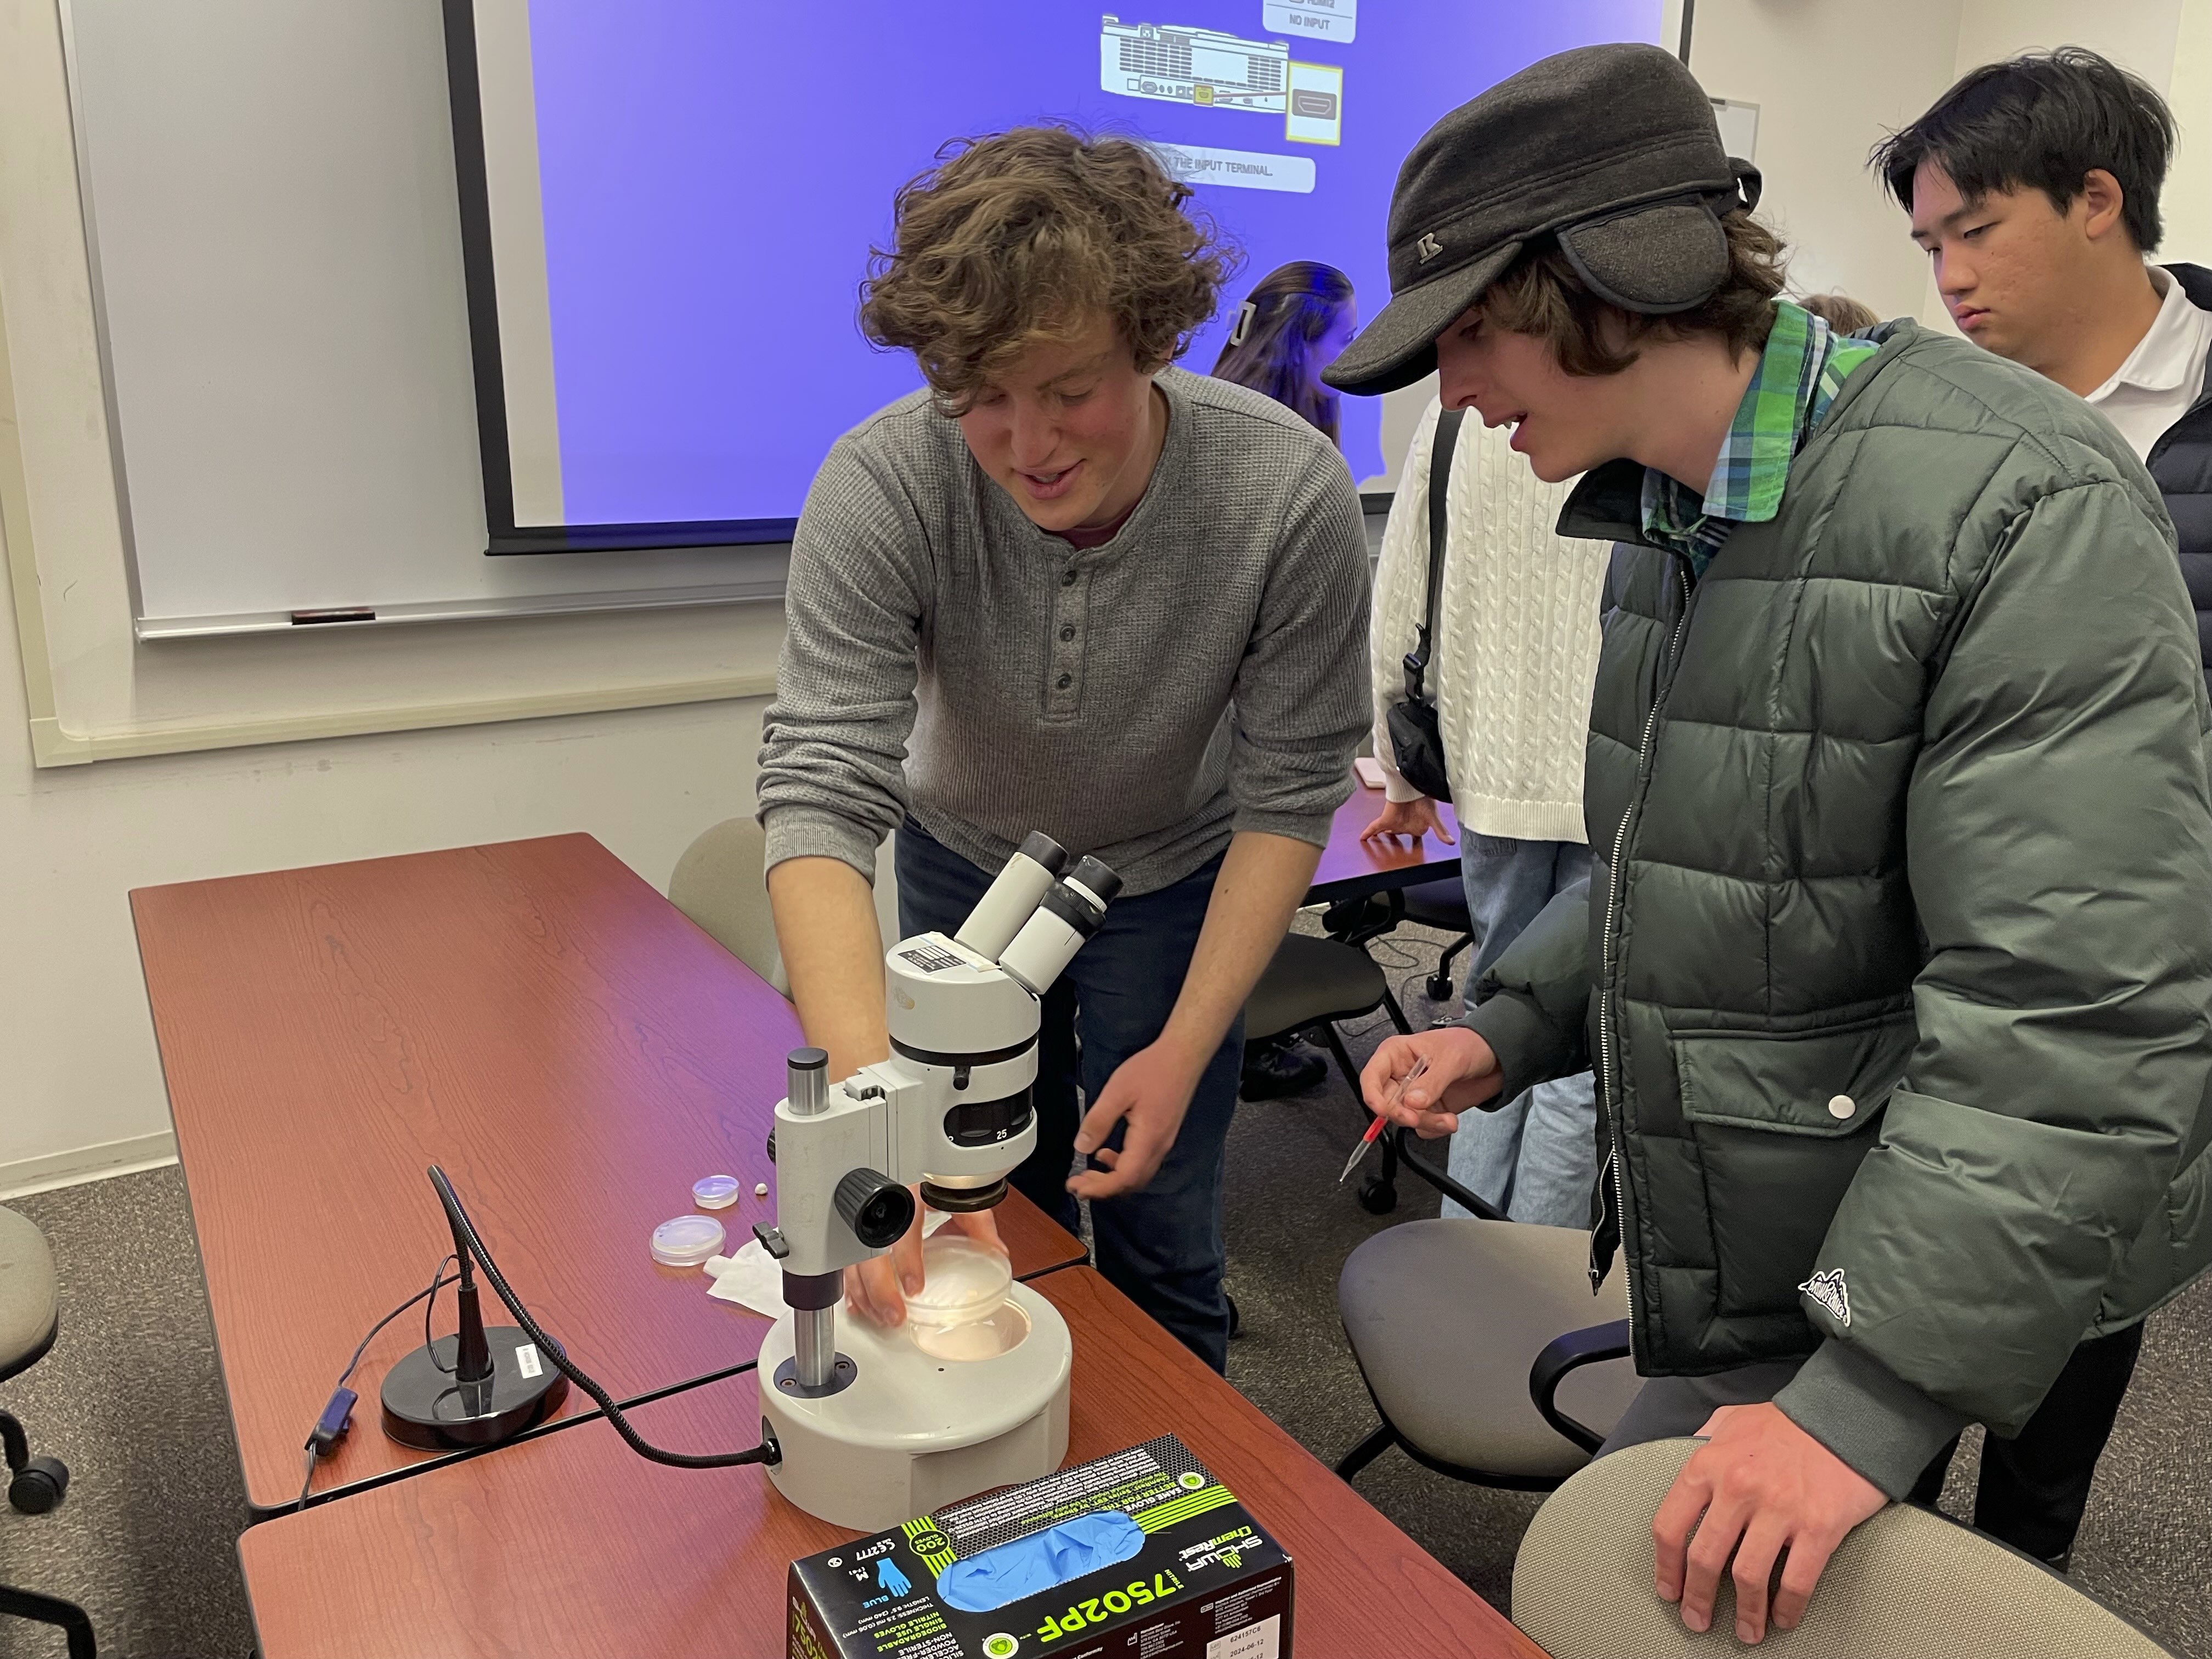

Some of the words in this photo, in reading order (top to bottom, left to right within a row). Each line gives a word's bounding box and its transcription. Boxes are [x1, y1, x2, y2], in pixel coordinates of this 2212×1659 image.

[1290, 13, 1302, 25] NO
[1304, 16, 1330, 30] INPUT
[1174, 157, 1193, 168] THE
[1195, 159, 1223, 171] INPUT
[1225, 161, 1273, 176] TERMINAL.
[996, 1129, 1007, 1140] 25
[1141, 1481, 1177, 1497] BETTER
[1155, 1487, 1182, 1500] SAME
[1120, 1494, 1142, 1504] FOR
[1123, 1497, 1156, 1512] GLOVE
[914, 1534, 938, 1544] GLOVES
[916, 1537, 945, 1551] 200
[1178, 1525, 1252, 1559] ChemRest
[1185, 1535, 1262, 1571] SHOWA
[855, 1571, 868, 1581] M
[1164, 1568, 1184, 1589] NITRILE
[862, 1595, 889, 1608] BLUE
[1037, 1573, 1176, 1642] 7502PF
[873, 1610, 889, 1619] (240
[896, 1602, 933, 1618] THICKNESS:
[857, 1616, 873, 1624] mm)
[907, 1611, 939, 1626] NITRILE
[913, 1617, 943, 1632] SINGLE
[842, 1629, 857, 1638] mm)
[873, 1623, 906, 1638] GLOVES
[877, 1623, 946, 1652] BIODEGRADABLE
[895, 1628, 912, 1638] USE
[898, 1632, 952, 1656] NON-STERILE
